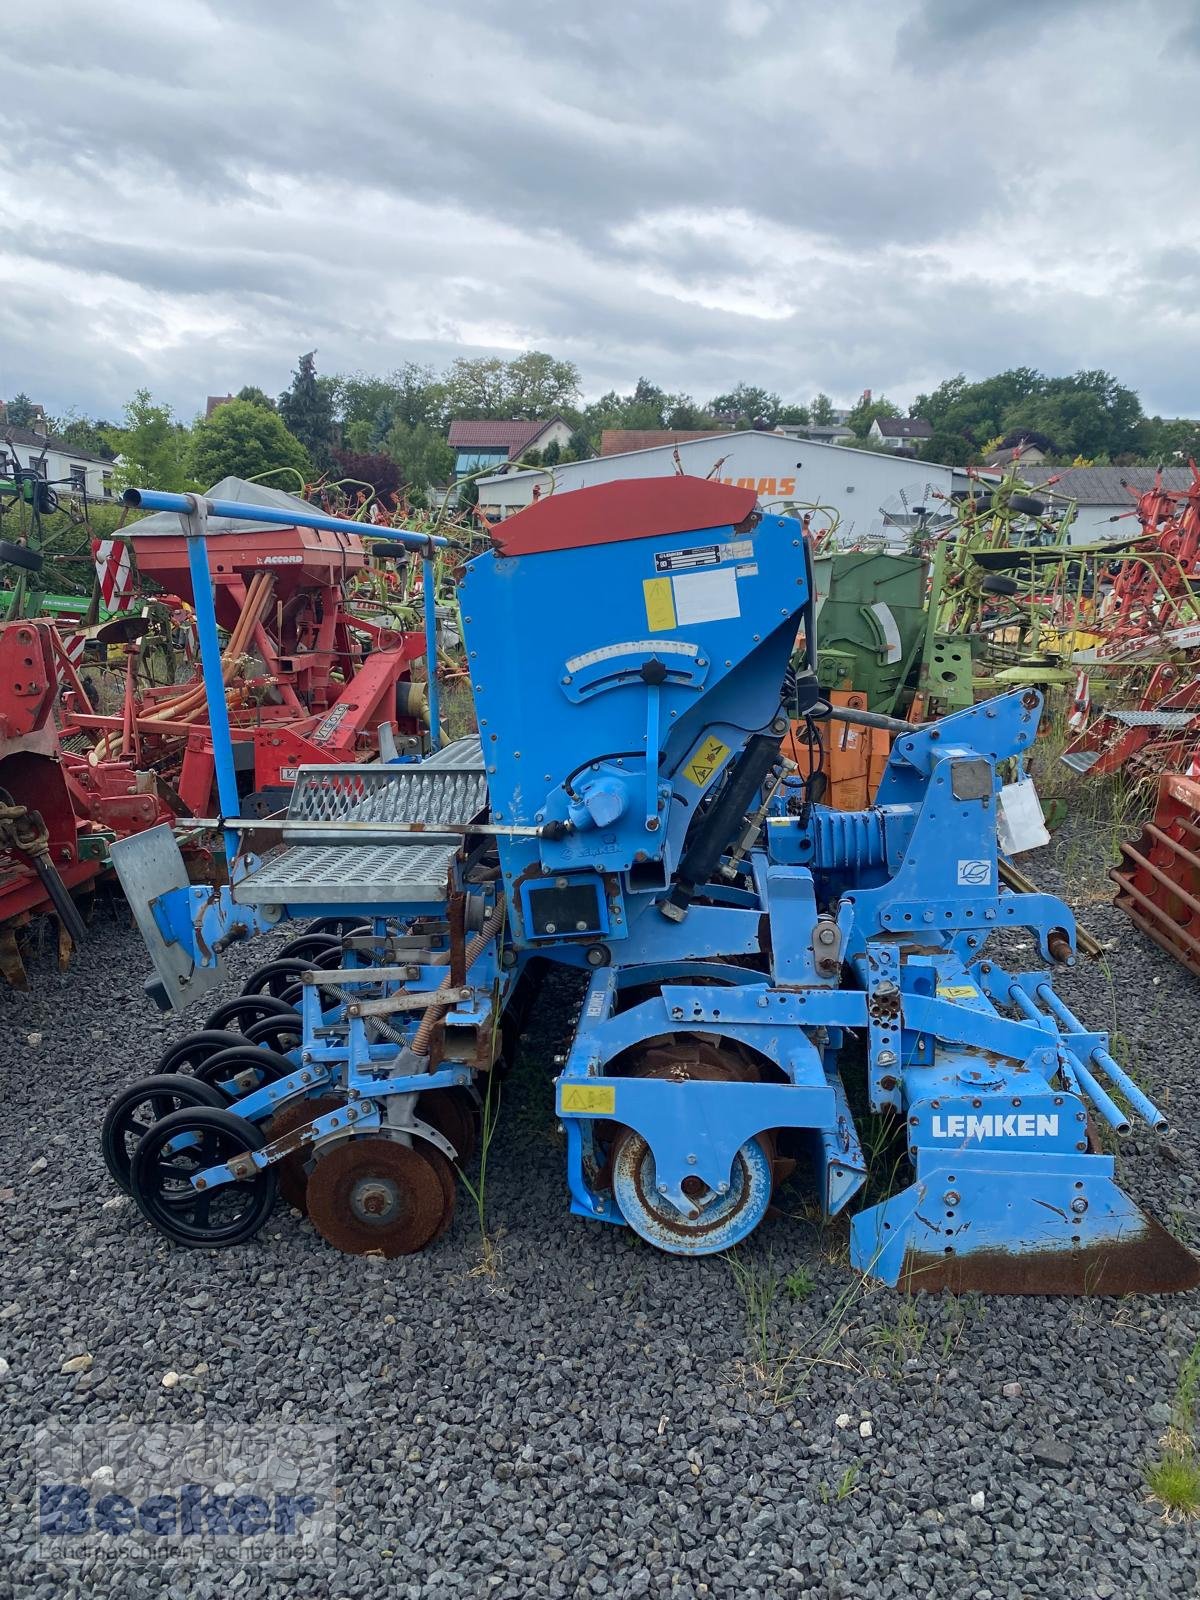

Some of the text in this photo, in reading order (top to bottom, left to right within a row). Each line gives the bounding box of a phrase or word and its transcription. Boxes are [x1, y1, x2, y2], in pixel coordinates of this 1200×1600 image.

[709, 476, 797, 496] AAS
[264, 555, 303, 564] ACCORD
[932, 1114, 1059, 1143] LEMKEN
